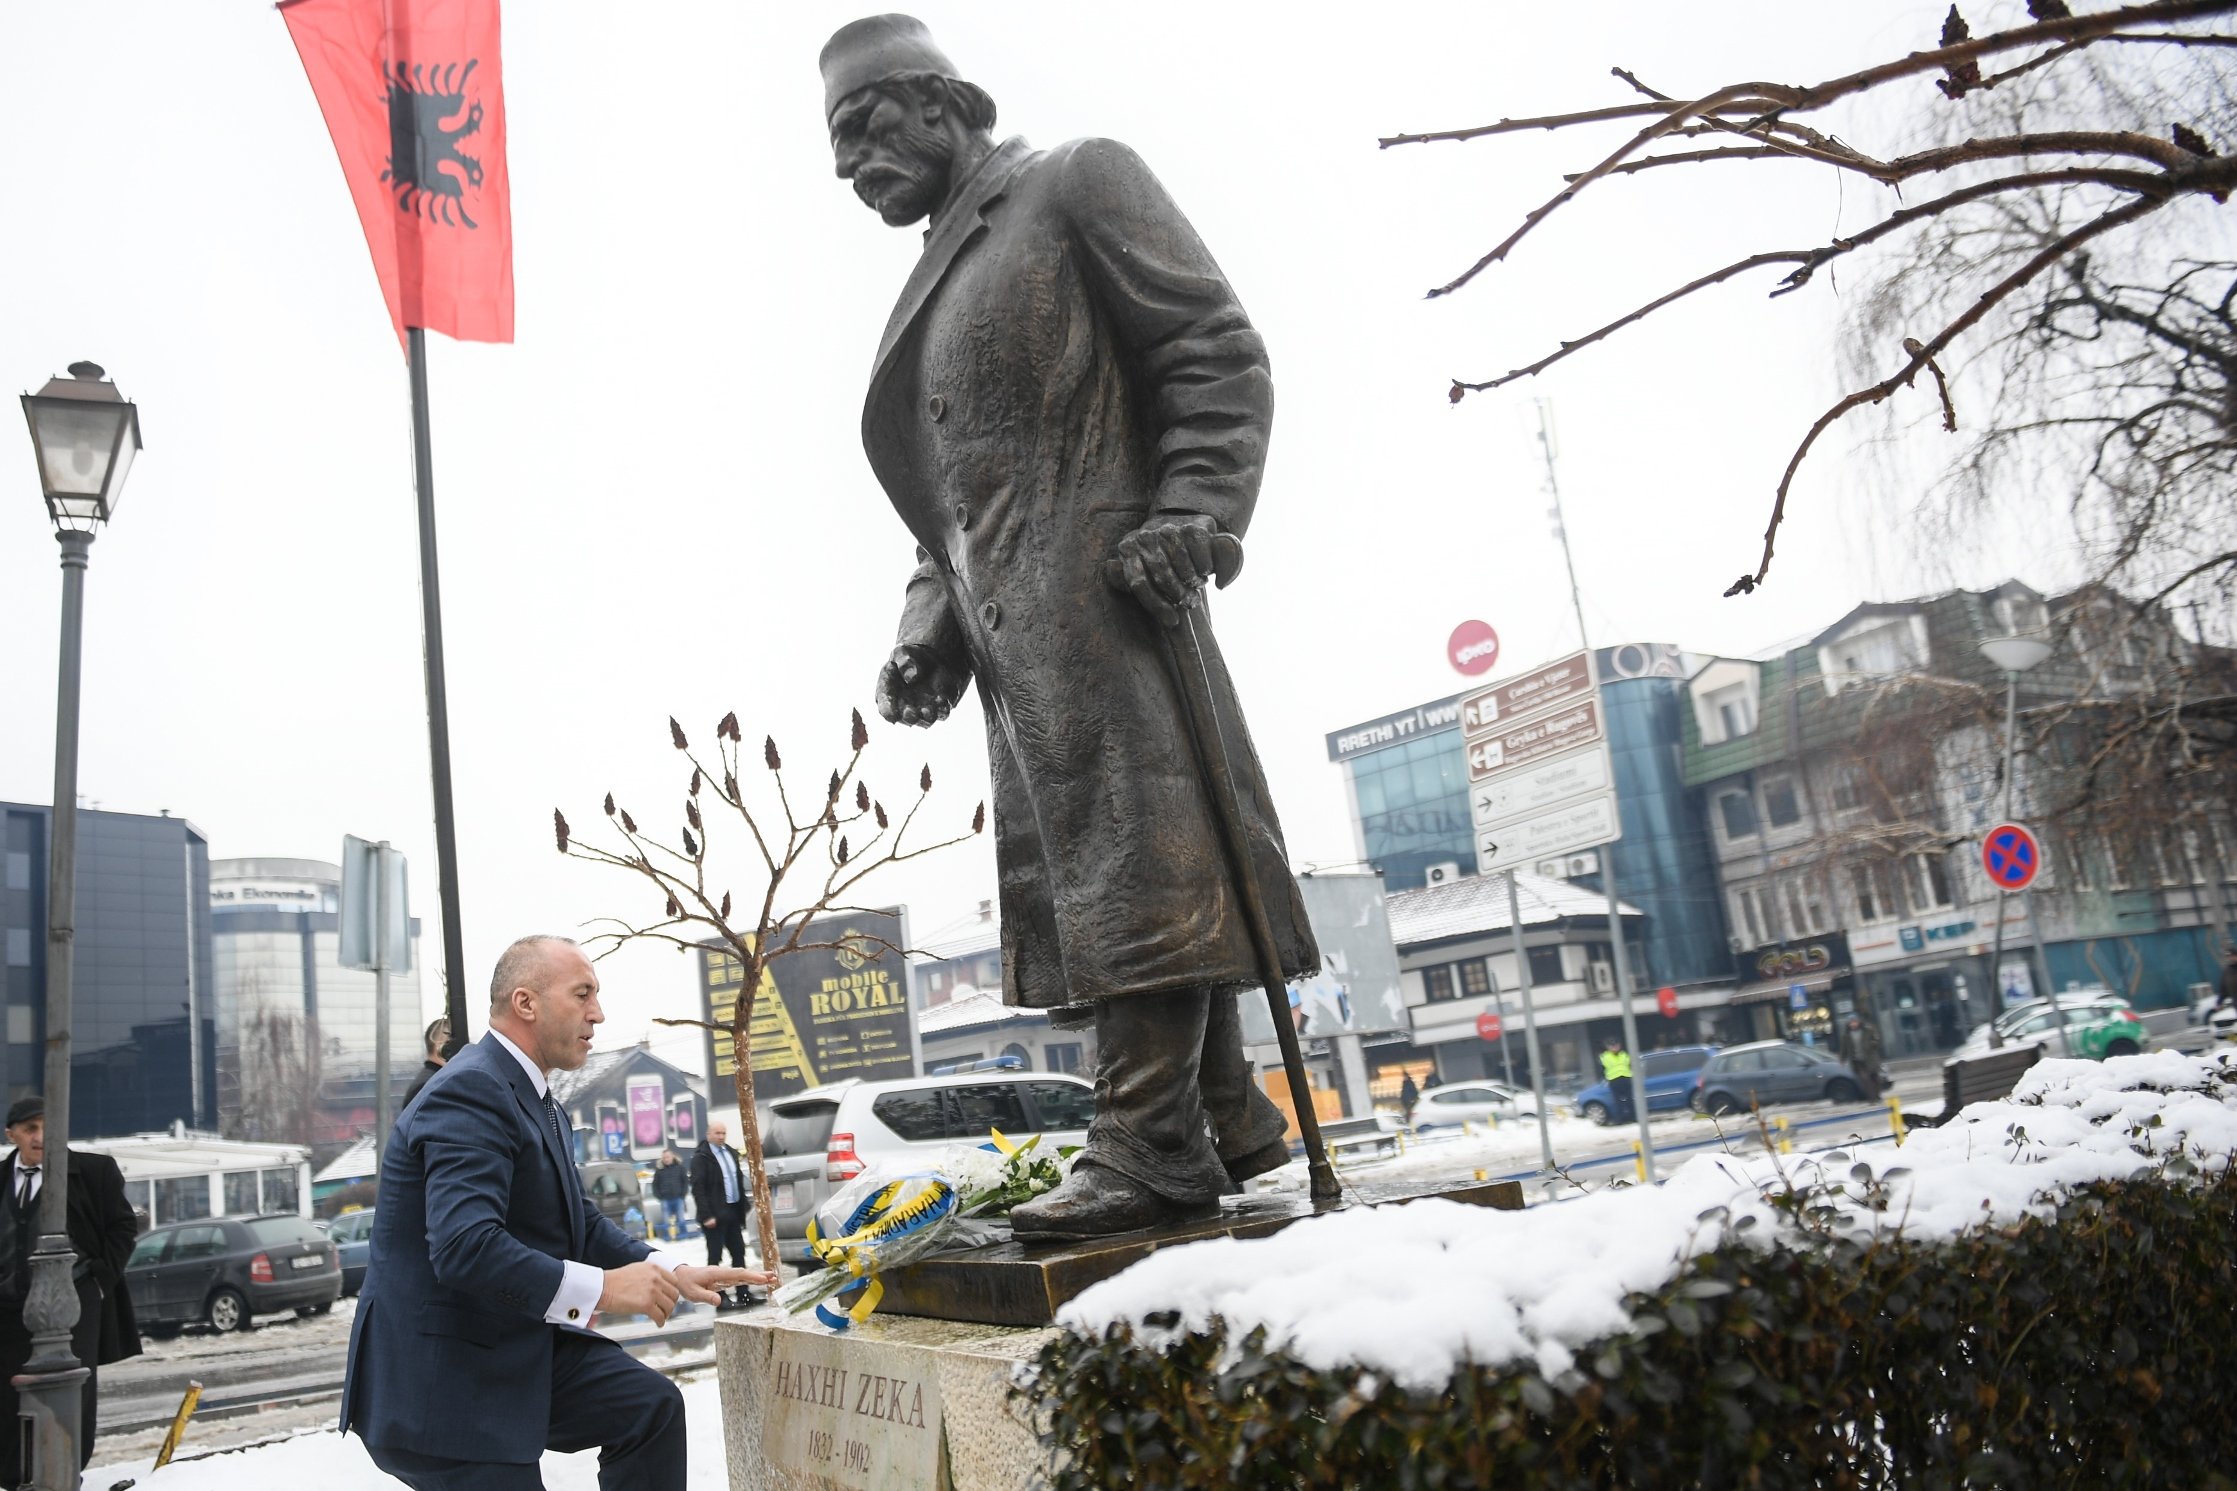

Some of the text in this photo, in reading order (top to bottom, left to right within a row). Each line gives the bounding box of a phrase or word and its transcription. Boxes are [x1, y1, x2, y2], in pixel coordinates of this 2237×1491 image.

[1337, 724, 1394, 754] RRETHI
[822, 970, 889, 993] mobile
[809, 982, 905, 1016] ROYAL
[774, 1360, 926, 1430] HAXHI ZEKA
